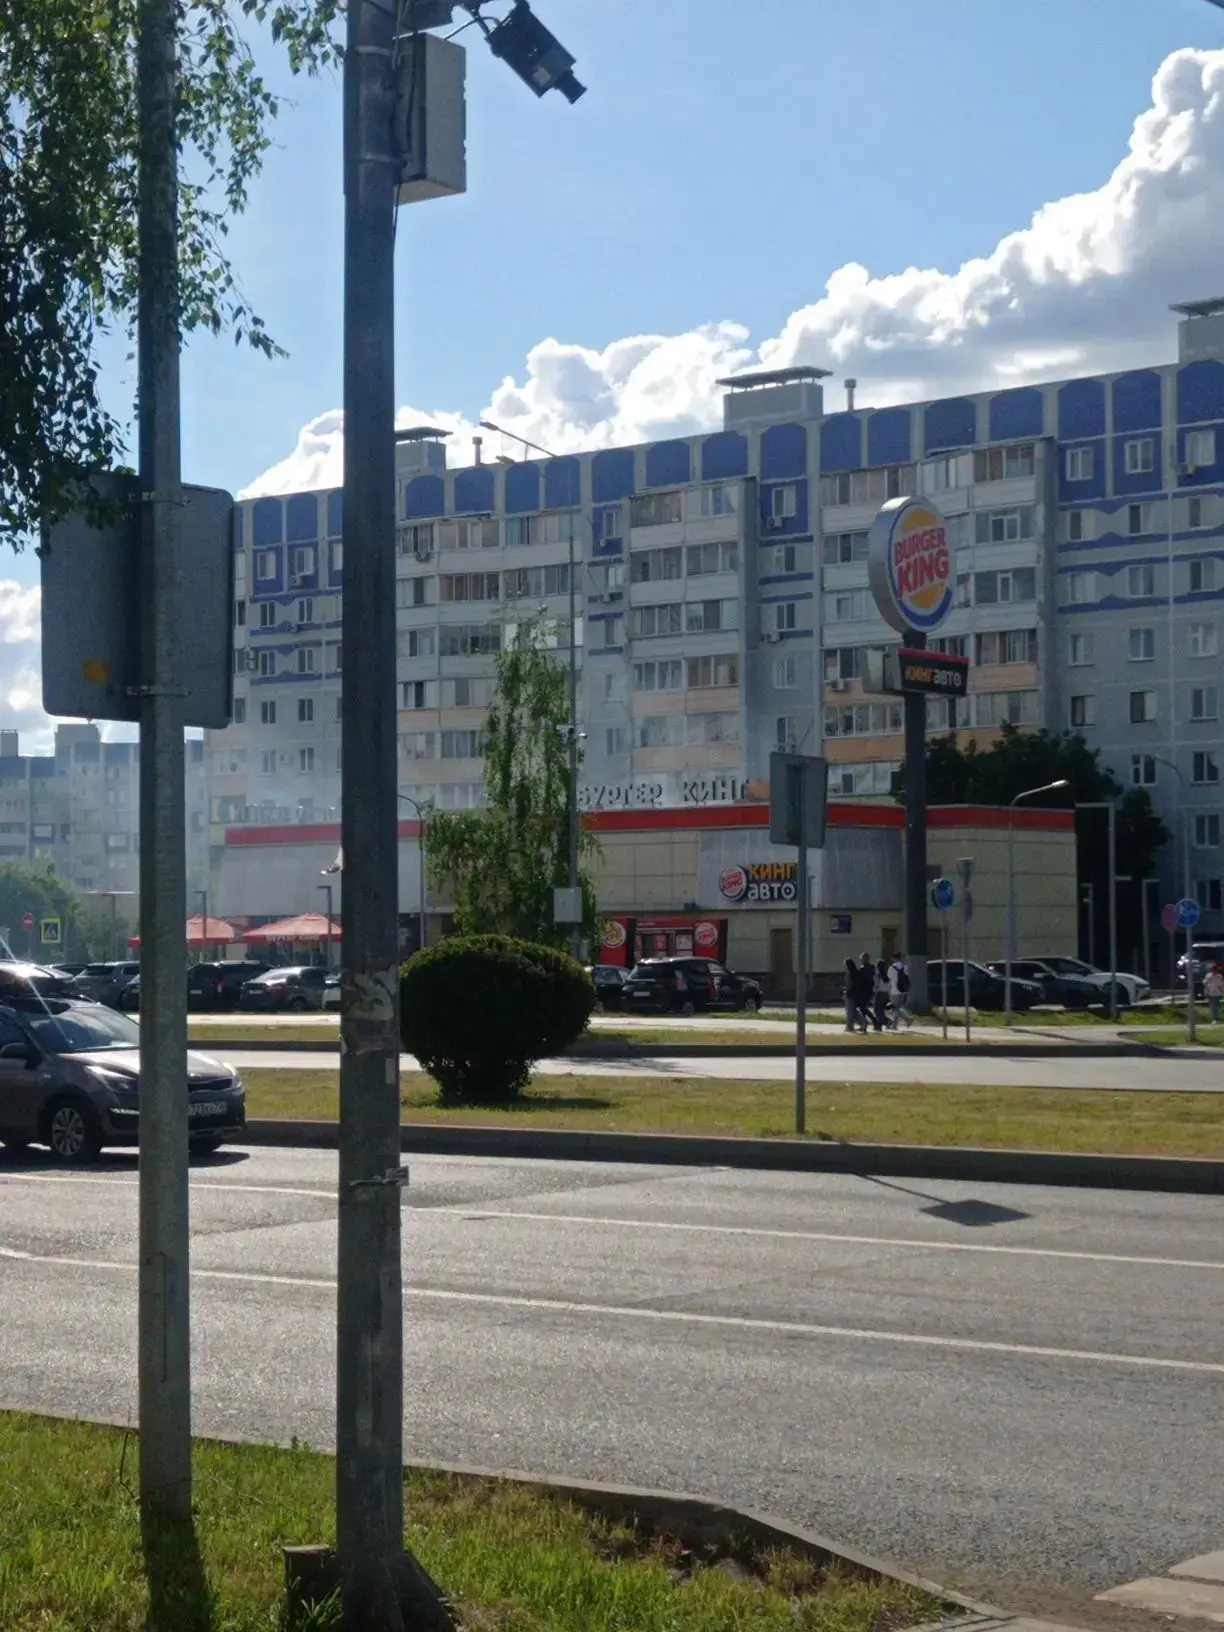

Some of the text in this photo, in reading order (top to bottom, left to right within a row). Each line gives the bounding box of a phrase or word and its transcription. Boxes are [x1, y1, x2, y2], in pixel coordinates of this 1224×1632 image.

[894, 527, 947, 566] BURGER
[897, 549, 949, 597] KING
[683, 777, 752, 803] КИНГ
[749, 863, 797, 880] КИНГ
